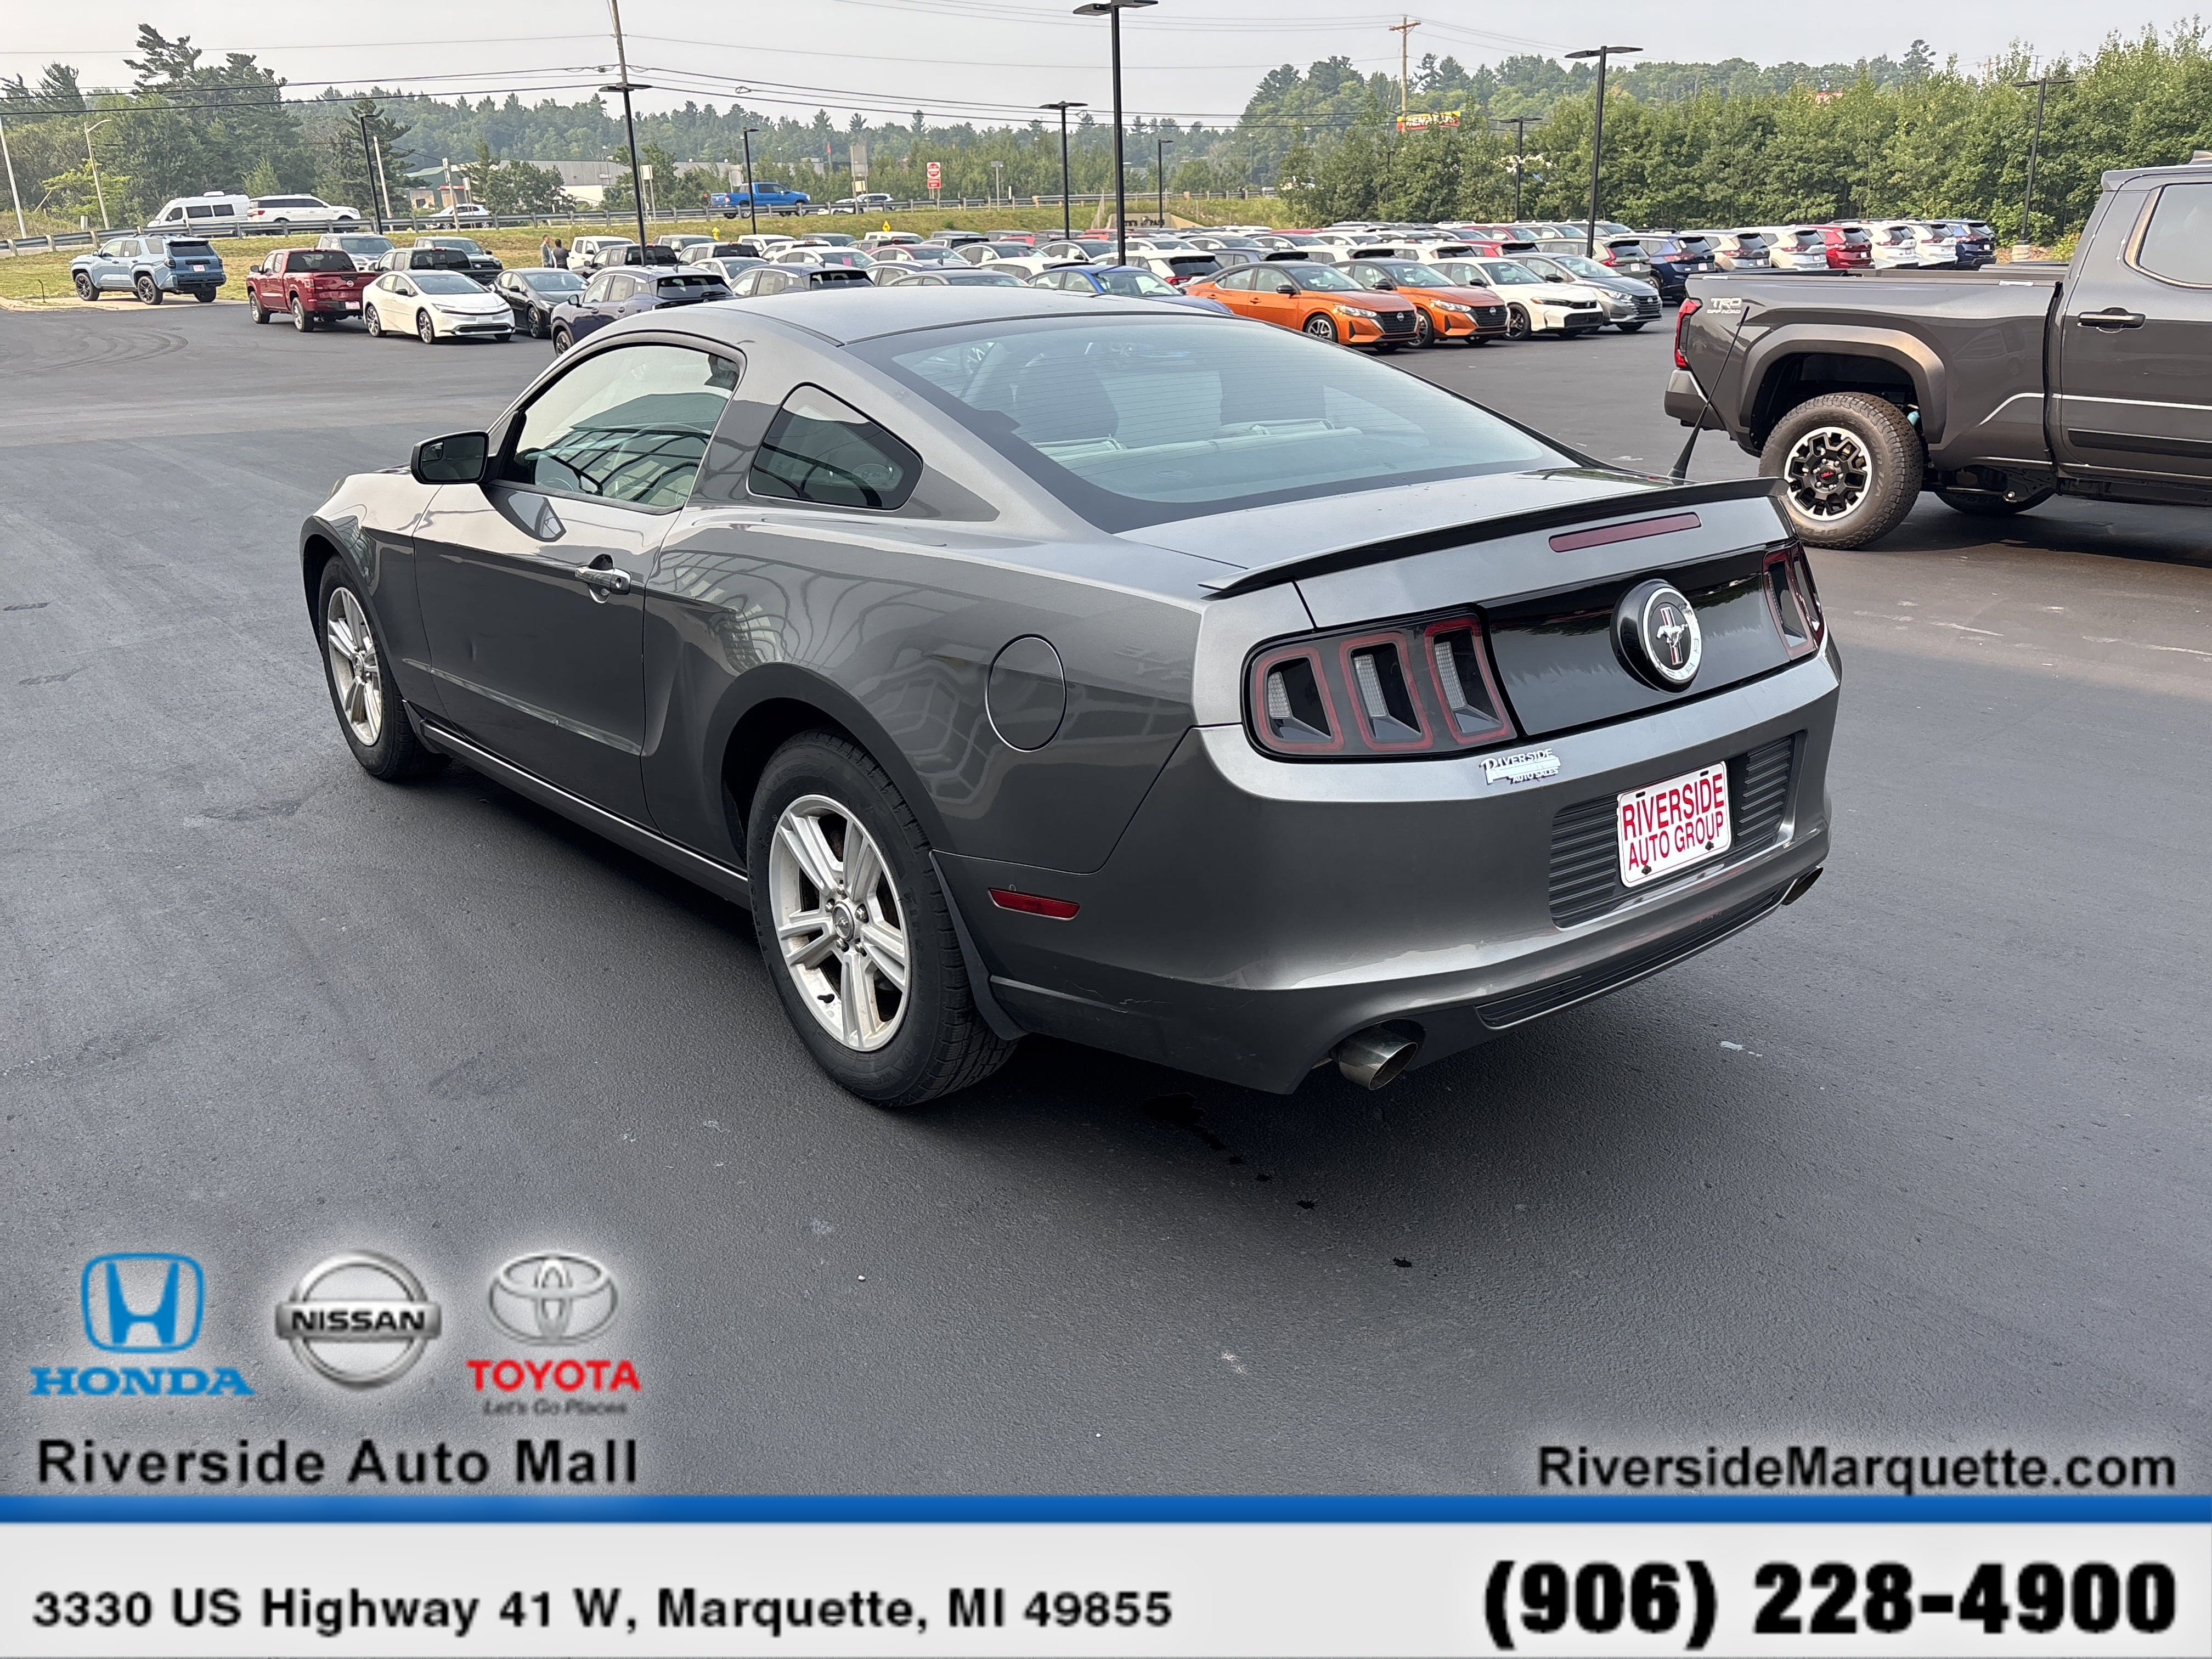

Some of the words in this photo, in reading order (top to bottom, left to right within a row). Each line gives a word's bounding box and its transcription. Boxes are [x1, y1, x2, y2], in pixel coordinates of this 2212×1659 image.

[1711, 297, 1742, 308] TRD
[1480, 748, 1553, 784] RIVERSIDE
[1512, 774, 1535, 783] AUTO
[1536, 768, 1559, 778] SALES
[1622, 774, 1724, 840] RIVERSIDE
[1628, 831, 1670, 871] AUTO
[1674, 811, 1724, 852] GROUP
